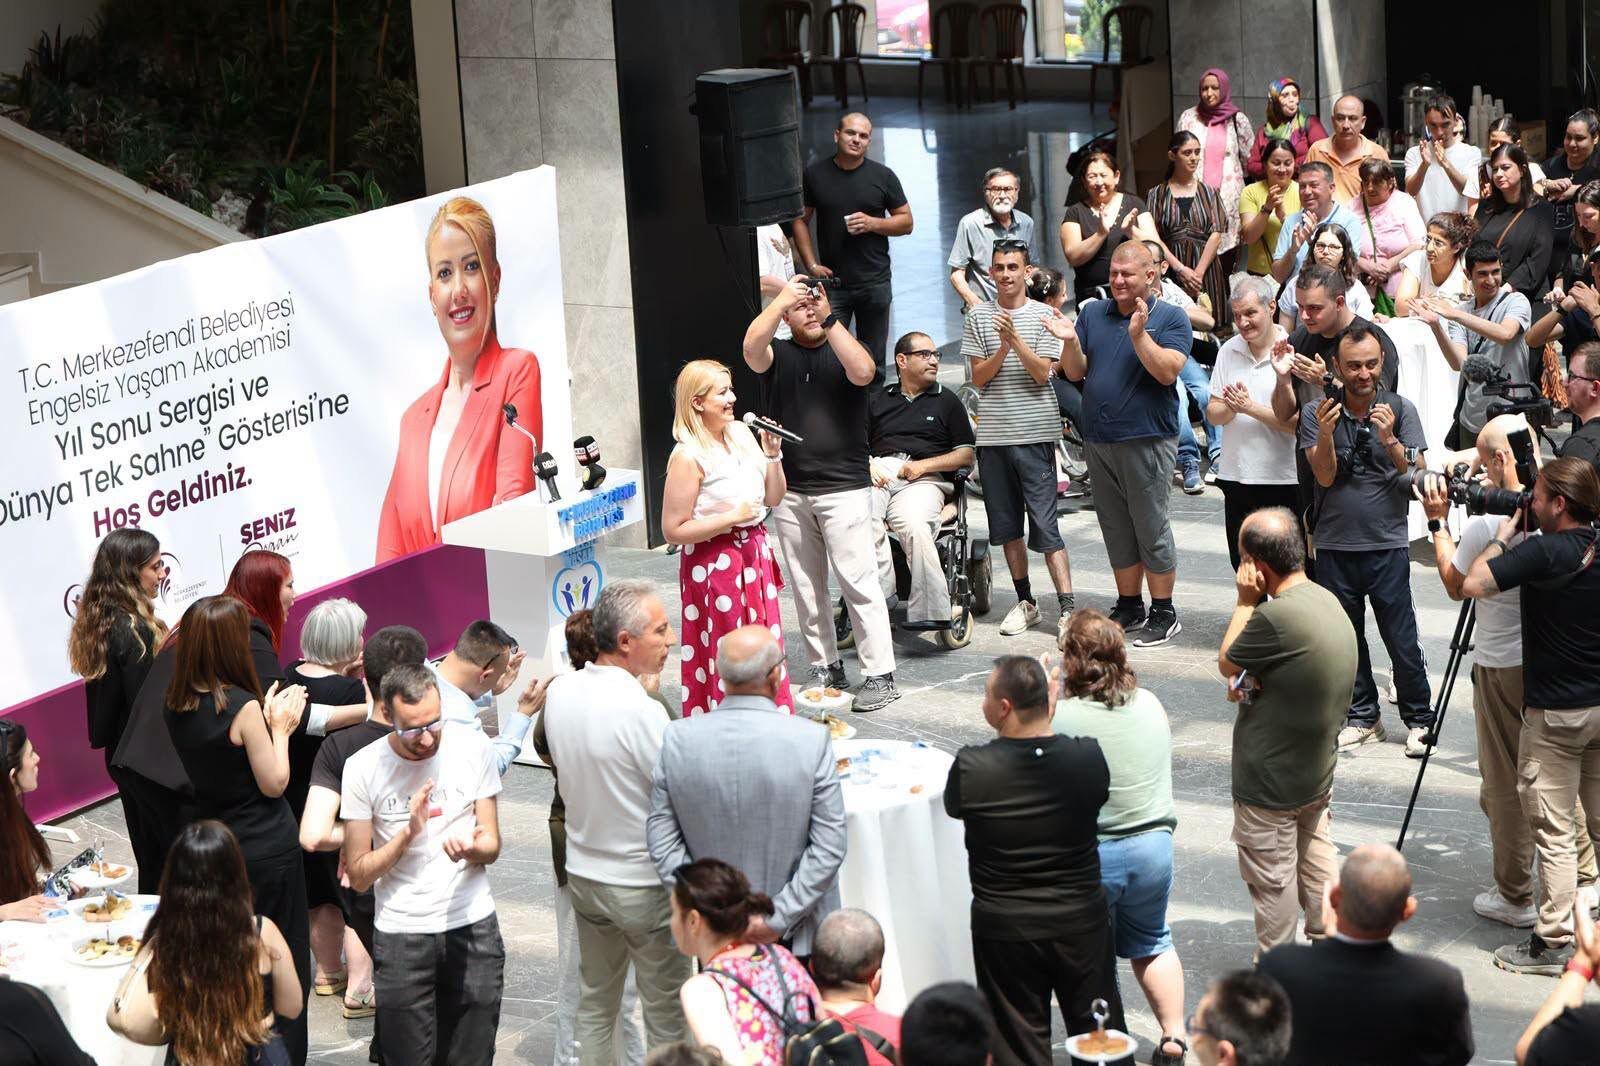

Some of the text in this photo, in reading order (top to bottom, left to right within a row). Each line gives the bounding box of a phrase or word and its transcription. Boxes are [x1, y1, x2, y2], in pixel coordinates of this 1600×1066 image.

[18, 291, 295, 393] T.C. Merkezefendi Belediyesi
[28, 323, 290, 426] Engelsiz Yaşam Akademisi
[54, 376, 269, 460] Yıl Sonu Sergisi ve
[80, 460, 124, 497] Tek
[93, 462, 253, 538] Hoş Geldiniz.
